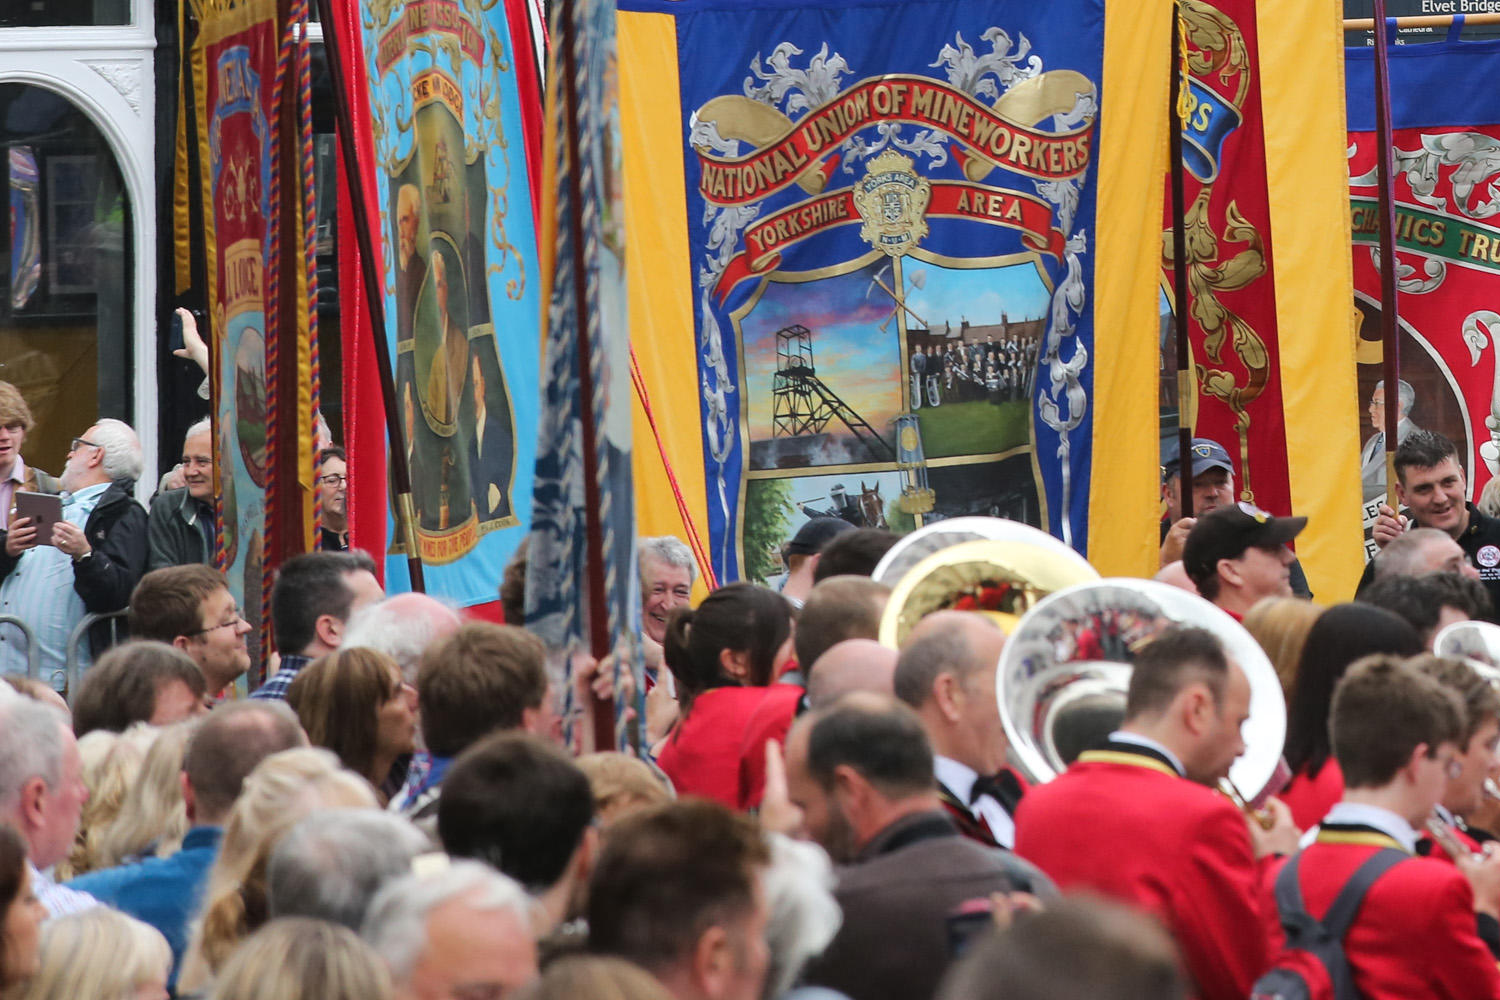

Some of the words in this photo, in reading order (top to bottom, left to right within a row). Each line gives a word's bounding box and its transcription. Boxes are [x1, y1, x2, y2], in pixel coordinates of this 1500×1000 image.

[1421, 0, 1456, 13] Elvet
[701, 143, 808, 199] NATIONAL
[802, 89, 870, 151] UNION
[872, 84, 908, 115] OF
[910, 85, 1089, 173] MINEWORKERS
[865, 173, 892, 190] YORKS
[894, 173, 915, 189] AREA
[751, 195, 849, 250] YORKSHIRE
[956, 189, 1024, 222] AREA
[1351, 206, 1447, 246] CHAICS
